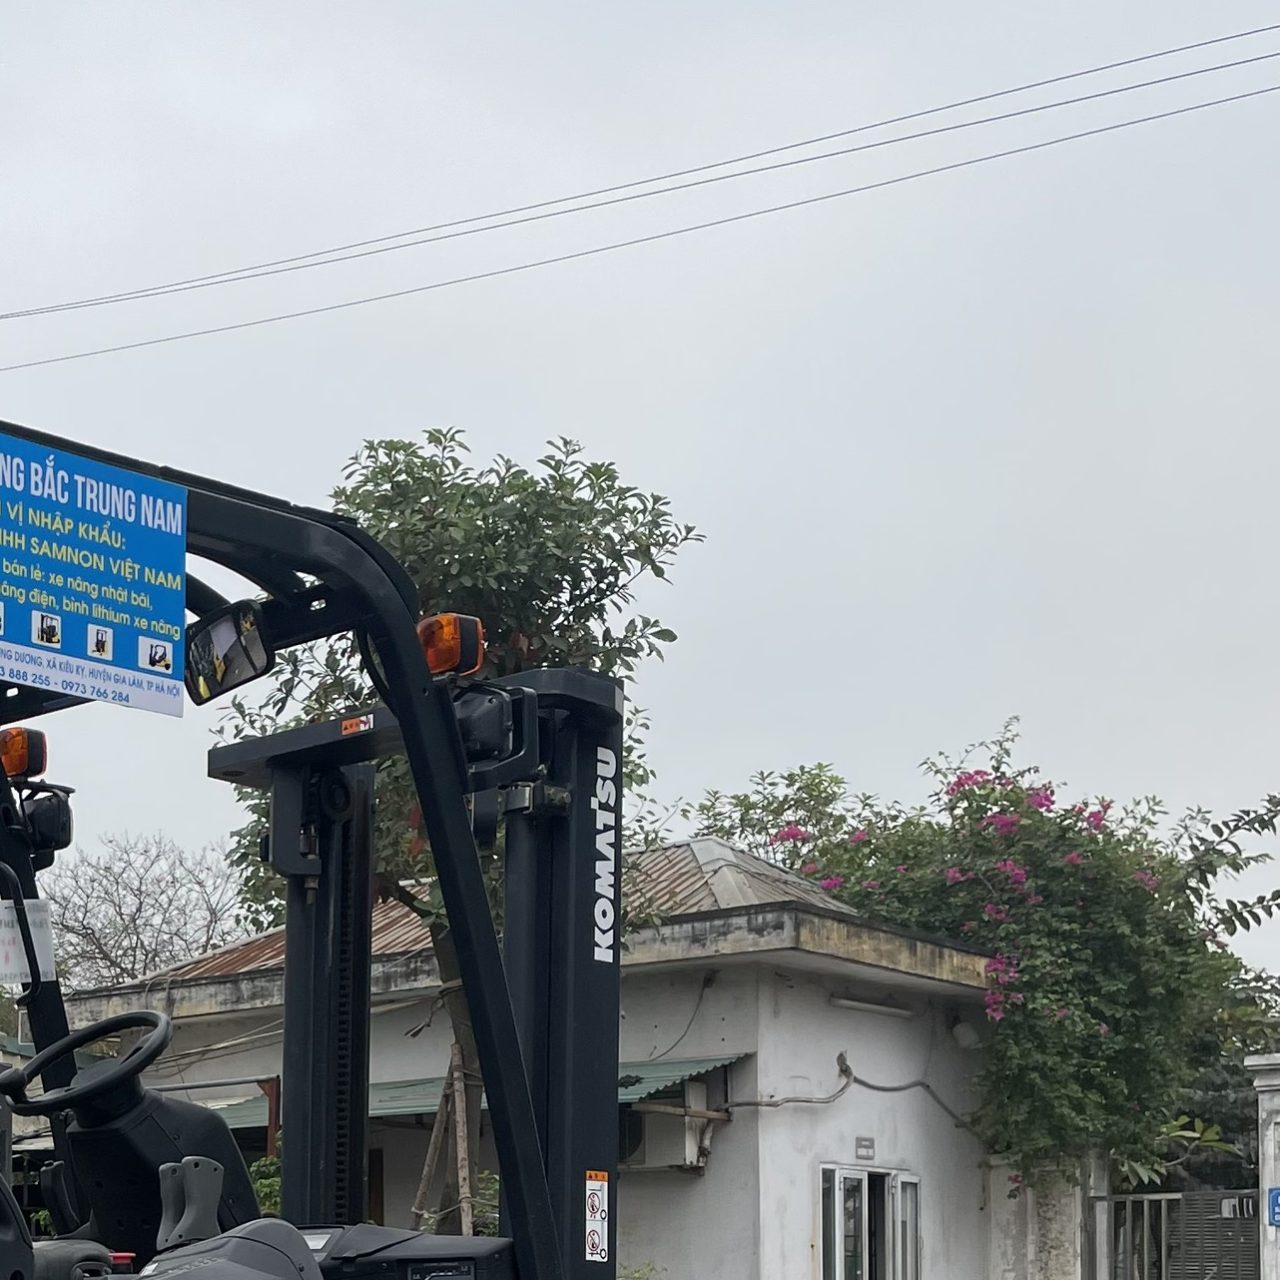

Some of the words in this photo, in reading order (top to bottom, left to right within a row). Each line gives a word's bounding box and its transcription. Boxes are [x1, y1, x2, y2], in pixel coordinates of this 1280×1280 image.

[30, 455, 69, 504] BẮC
[73, 475, 136, 522] TRUNG
[140, 494, 182, 535] NAM
[6, 501, 23, 526] VỊ
[28, 507, 74, 535] NHẬP
[78, 520, 126, 550] KHẨU:
[2, 558, 27, 578] bán
[49, 572, 64, 586] xe
[67, 576, 99, 599] nâng
[102, 586, 128, 605] nhật
[30, 537, 105, 571] SAMNON
[109, 556, 140, 582] VIỆT
[144, 568, 182, 591] NAM
[29, 588, 59, 610] điện,
[62, 596, 89, 616] bình
[92, 603, 130, 625] lithium
[133, 616, 148, 629] xe
[151, 619, 180, 640] nâng
[8, 669, 28, 682] 888
[31, 673, 51, 687] 255
[61, 680, 87, 694] 0973
[90, 686, 109, 699] 766
[111, 690, 130, 703] 284
[88, 667, 113, 683] HUYỆN
[113, 673, 127, 684] GIA
[590, 746, 617, 963] KOMATSU
